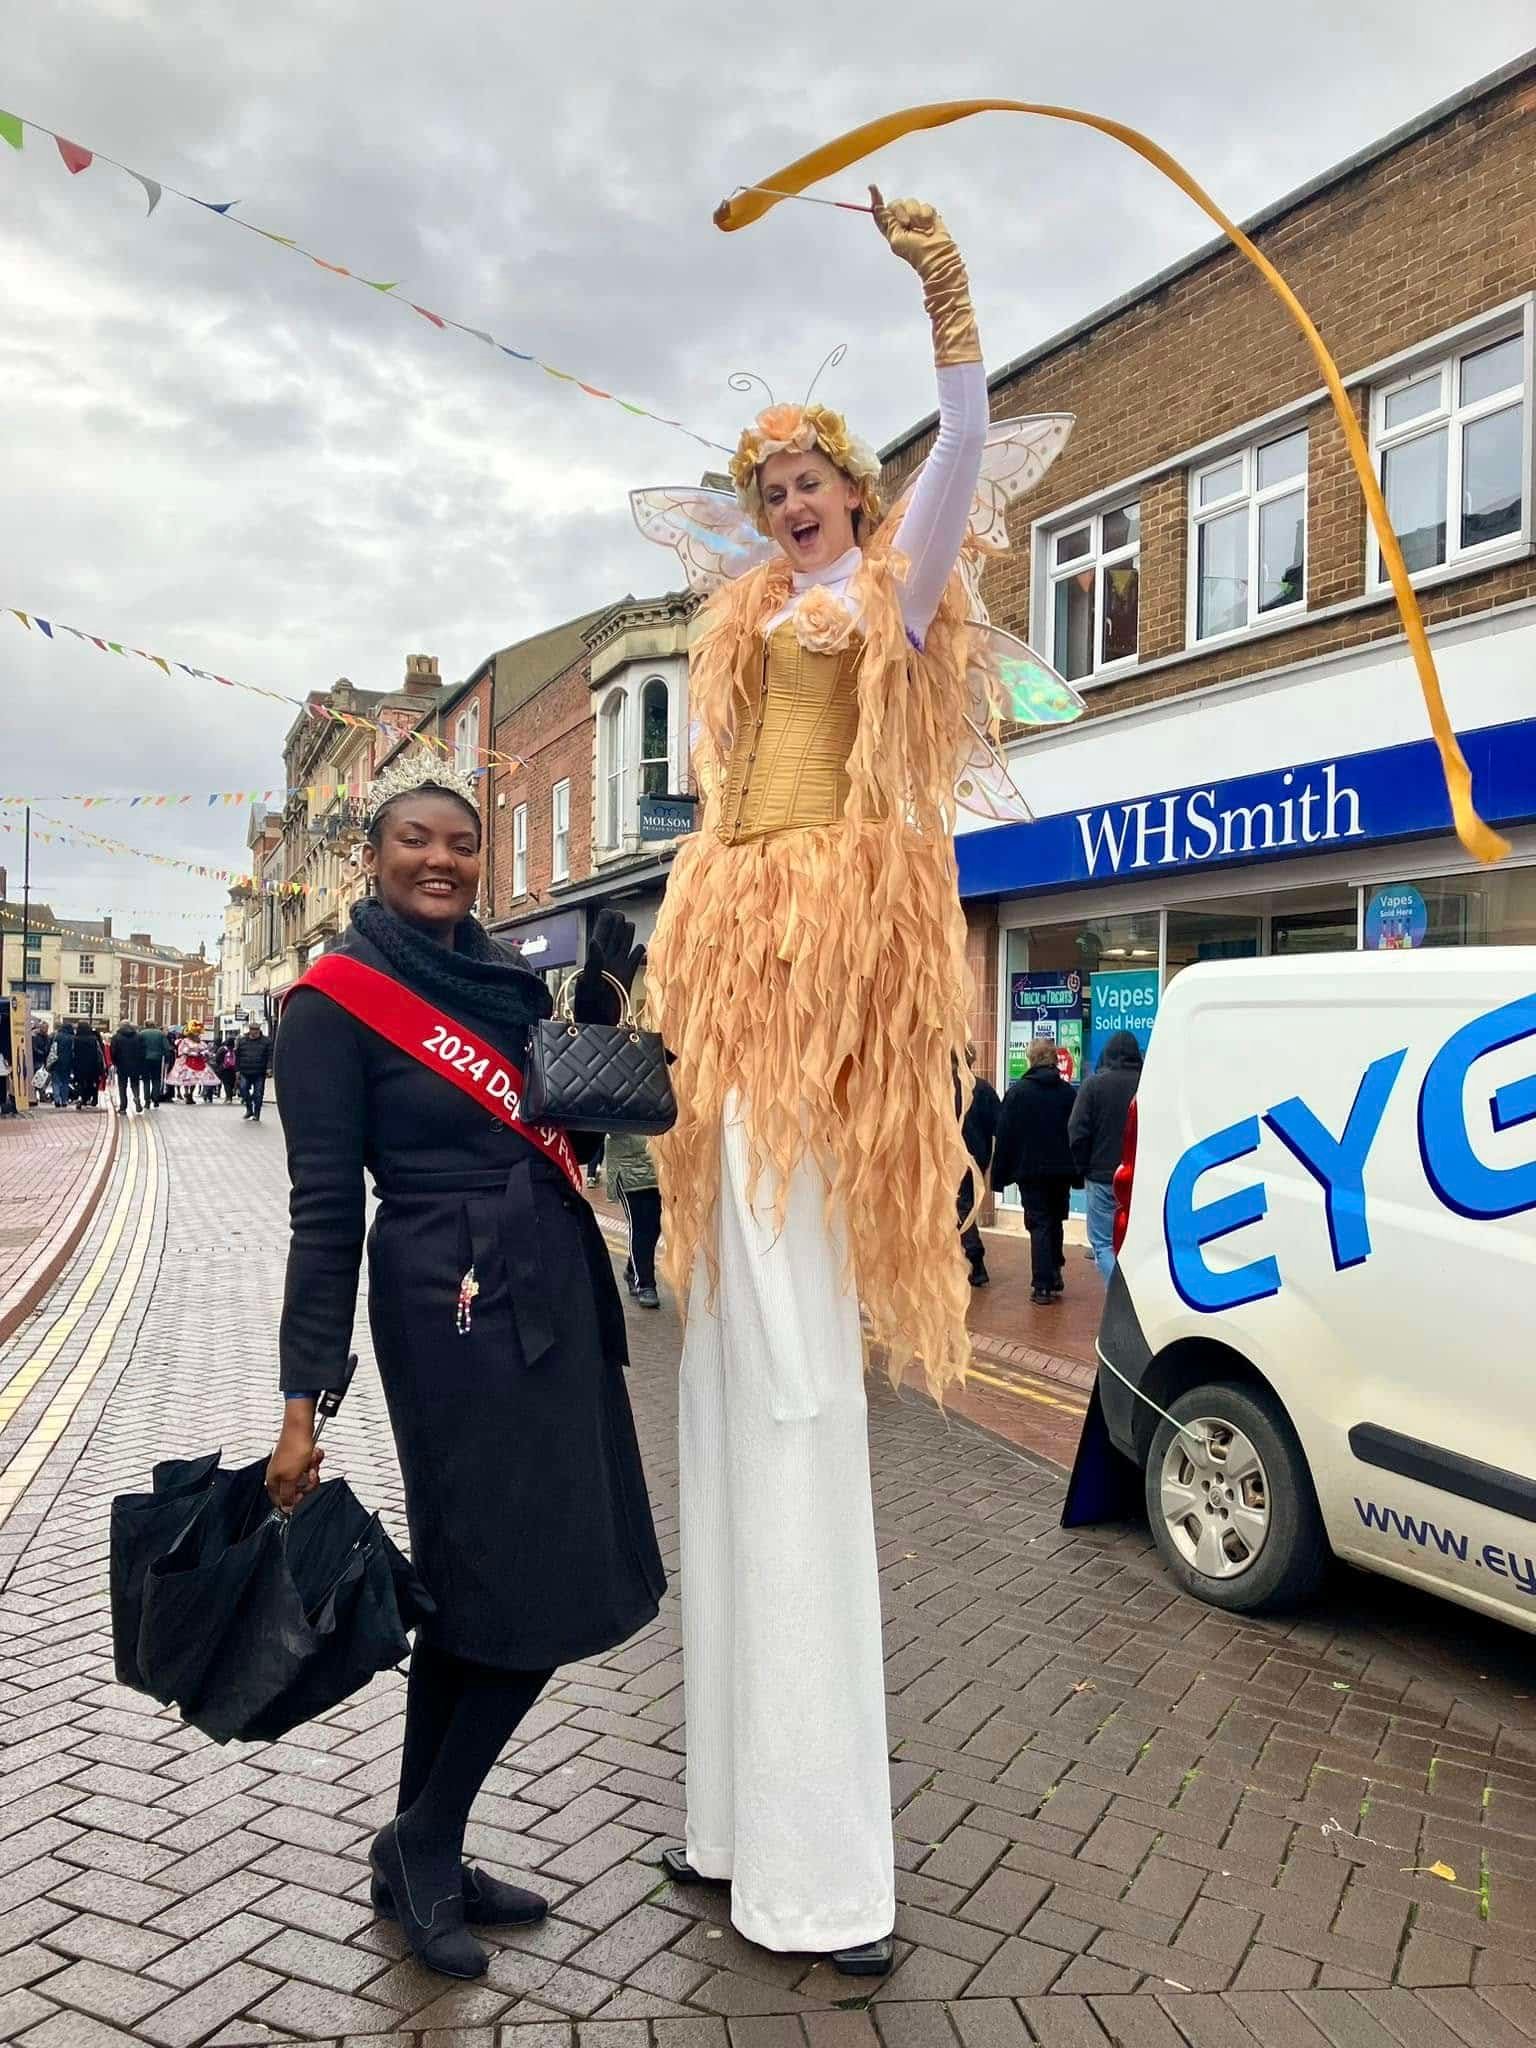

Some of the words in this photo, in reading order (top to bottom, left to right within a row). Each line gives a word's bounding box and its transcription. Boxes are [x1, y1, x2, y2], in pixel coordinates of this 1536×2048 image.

[643, 816, 691, 828] MOLSOM
[1076, 763, 1365, 876] WHSmith
[1380, 895, 1413, 907] Vapes
[1396, 908, 1412, 916] Here
[1020, 991, 1040, 1005] TRICK
[1046, 990, 1073, 1004] TREATS
[1096, 985, 1154, 1013] Vapes
[1095, 1016, 1120, 1030] Sold
[1125, 1016, 1153, 1030] Here
[422, 1025, 490, 1082] 2024
